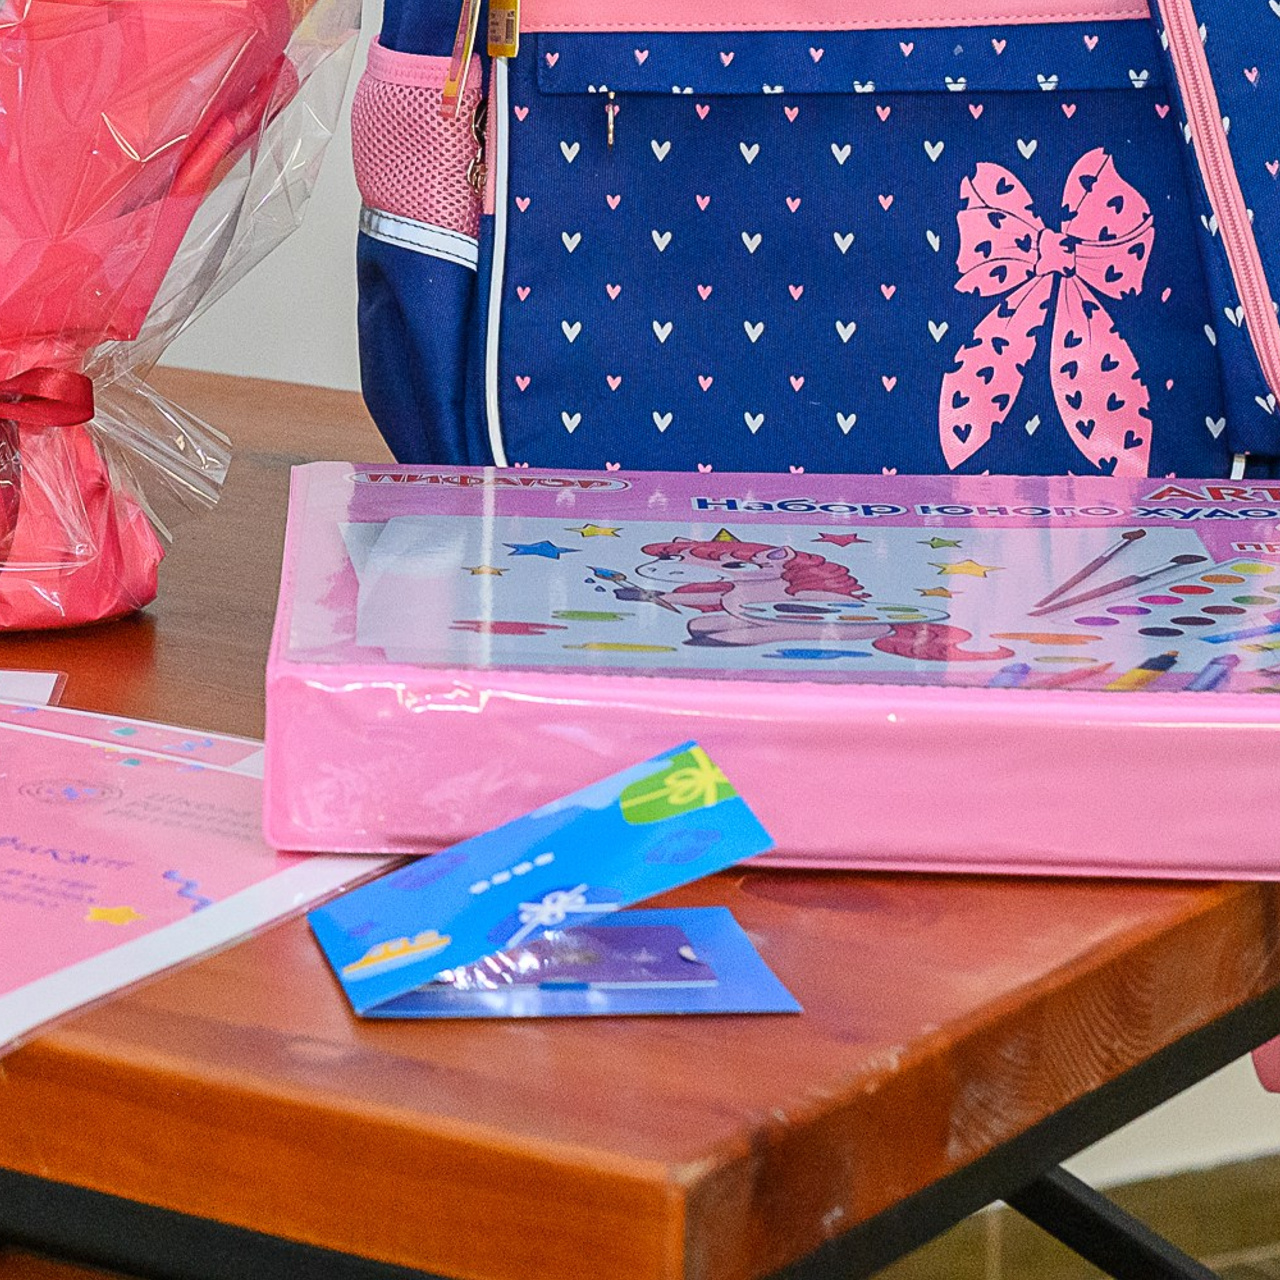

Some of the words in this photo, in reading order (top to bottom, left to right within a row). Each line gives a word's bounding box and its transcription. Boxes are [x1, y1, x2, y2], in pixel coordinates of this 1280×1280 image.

[695, 497, 903, 517] Набор
[919, 505, 1120, 517] юного
[1136, 507, 1280, 520] худо
